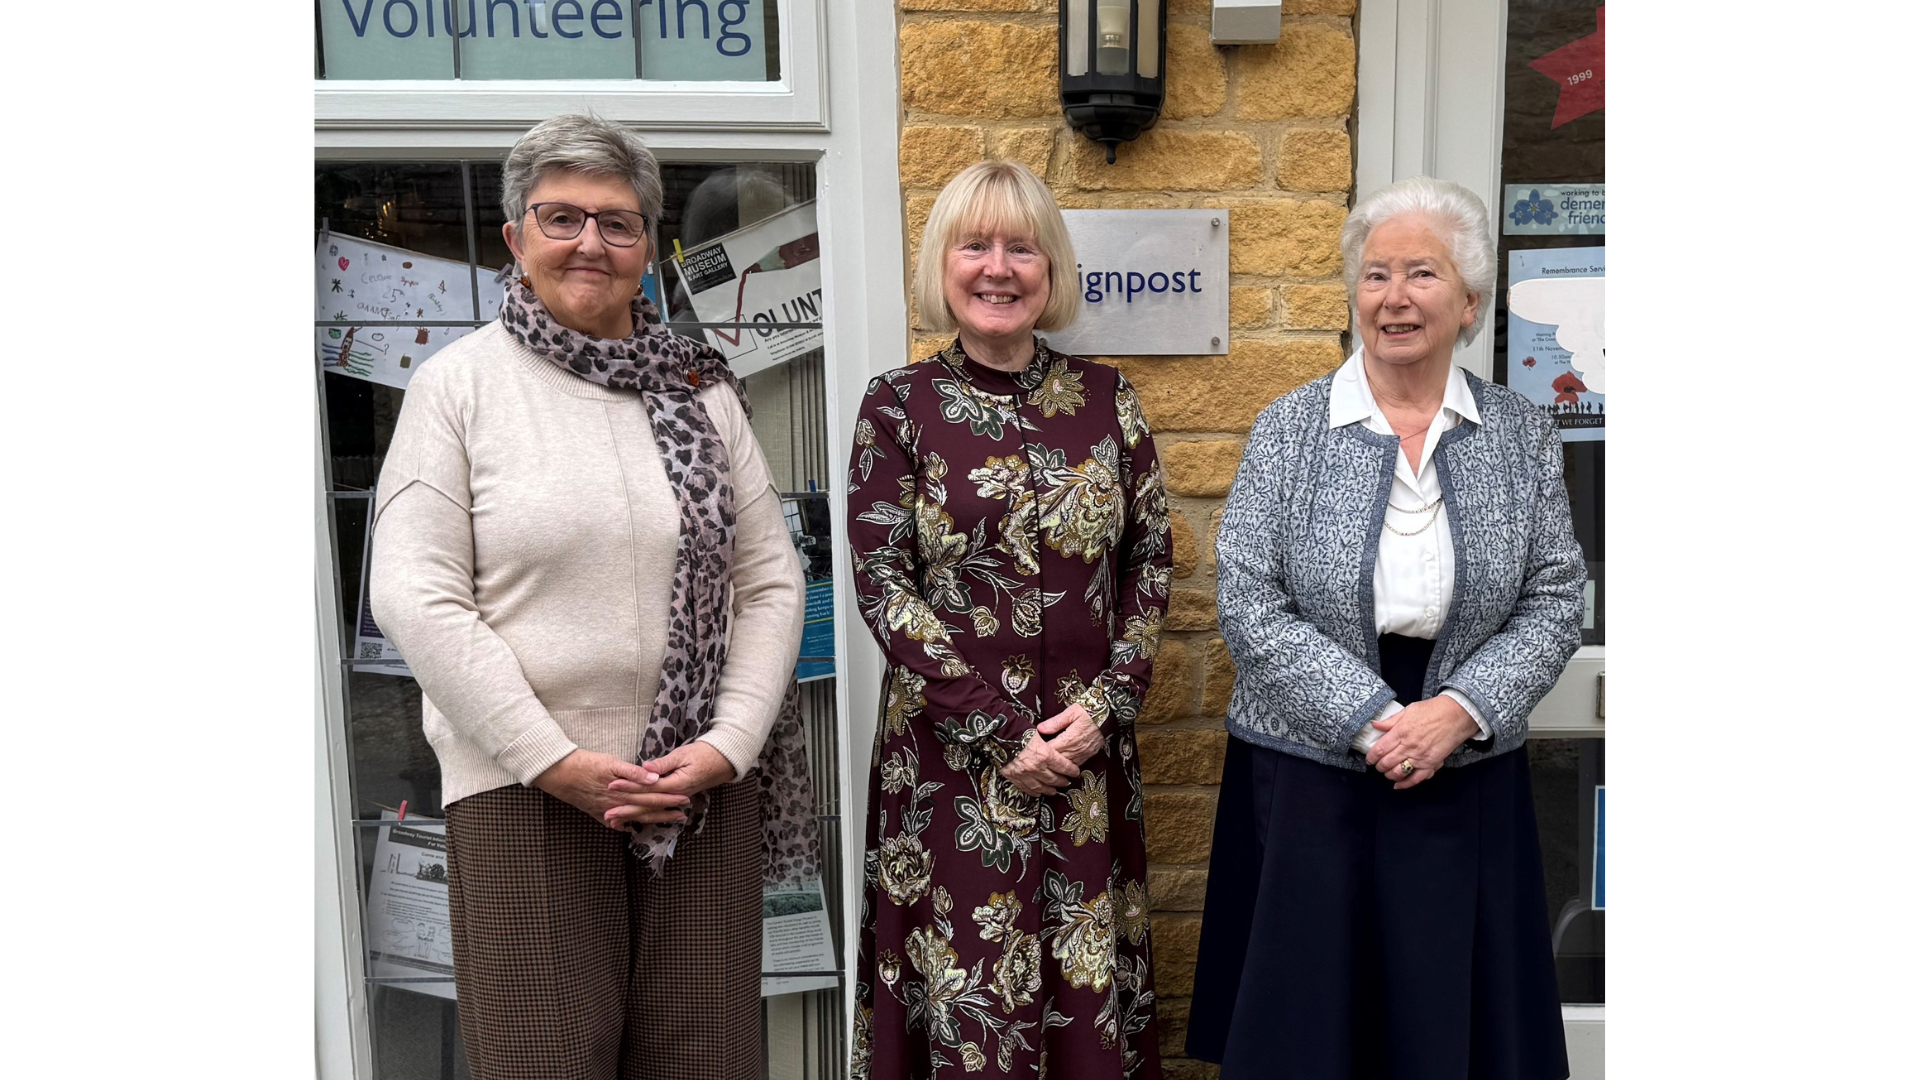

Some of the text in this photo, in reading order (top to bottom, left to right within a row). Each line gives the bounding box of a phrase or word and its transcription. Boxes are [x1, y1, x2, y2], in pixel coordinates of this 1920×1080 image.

[346, 0, 752, 57] Volunteering
[1567, 69, 1593, 86] 1999
[1560, 189, 1590, 198] working
[681, 246, 722, 268] BROADWAY
[683, 253, 727, 276] MUSEUM
[693, 271, 704, 280] ART
[704, 262, 728, 275] GALLERY
[1541, 266, 1588, 275] Remembrance
[1561, 418, 1573, 426] WE
[1574, 417, 1603, 426] FORGET
